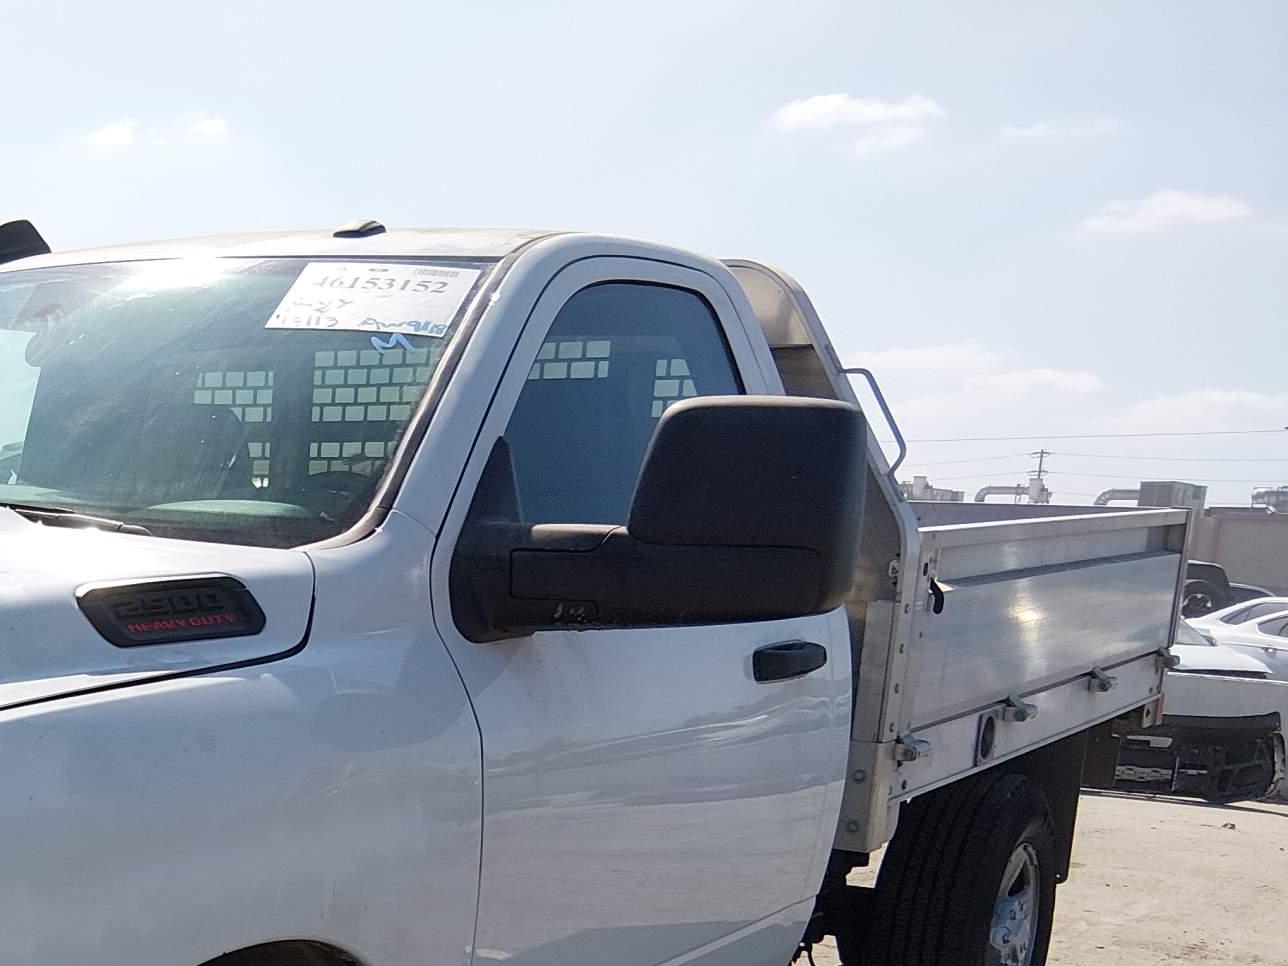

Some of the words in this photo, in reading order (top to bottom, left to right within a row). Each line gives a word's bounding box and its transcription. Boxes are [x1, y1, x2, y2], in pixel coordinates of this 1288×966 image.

[313, 275, 448, 294] 46153152
[127, 618, 185, 633] HEAVY
[189, 613, 234, 626] DUTY
